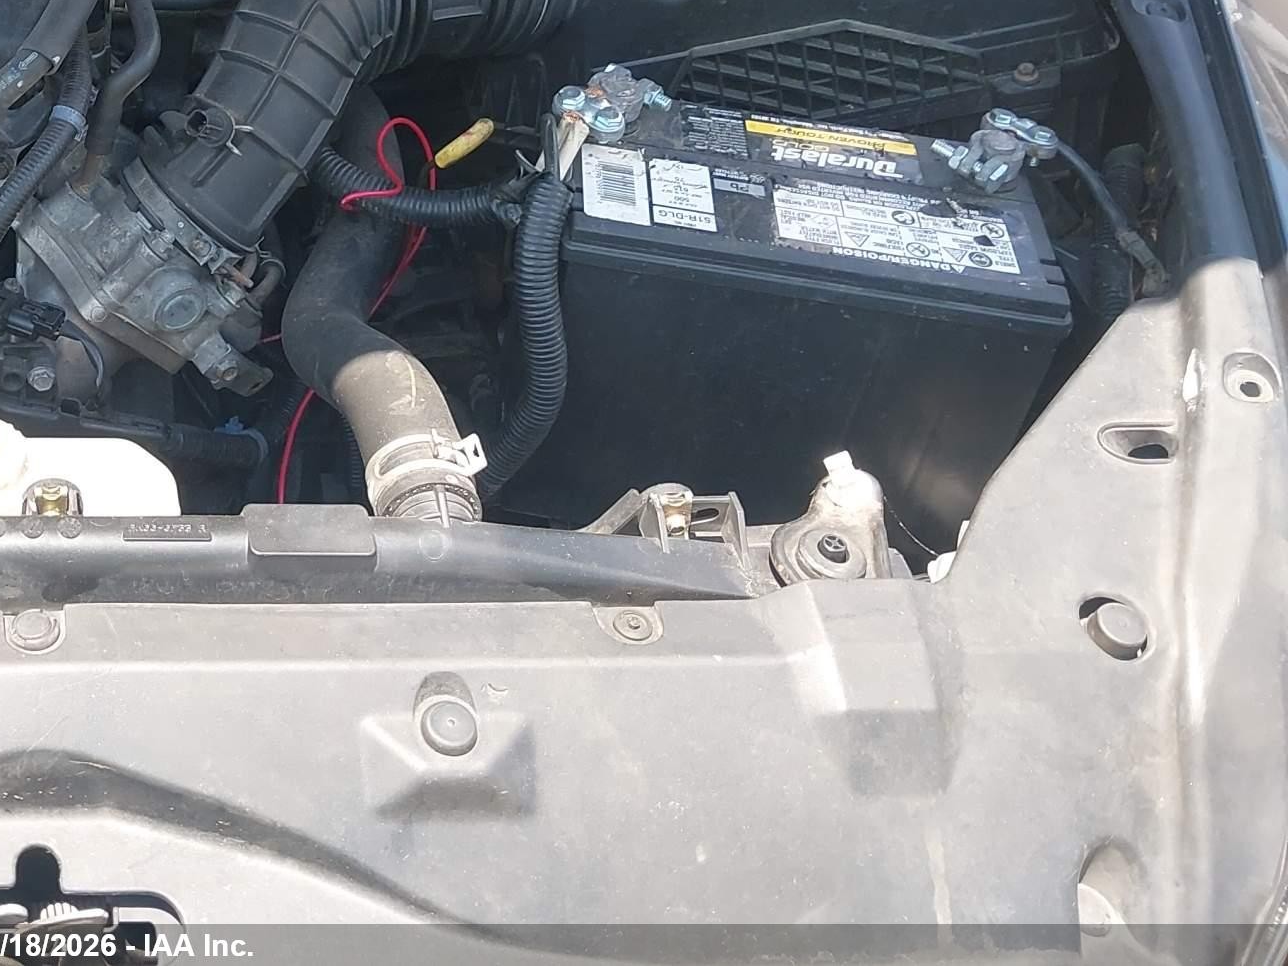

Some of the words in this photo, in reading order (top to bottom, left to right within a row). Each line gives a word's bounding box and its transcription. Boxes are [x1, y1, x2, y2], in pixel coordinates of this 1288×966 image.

[775, 125, 825, 139] TOUGH
[828, 134, 885, 148] PROVEN
[769, 143, 903, 178] Duralast
[730, 182, 748, 192] Pb
[658, 209, 711, 223] 51R-DLG
[833, 247, 950, 271] DANGER/POISON
